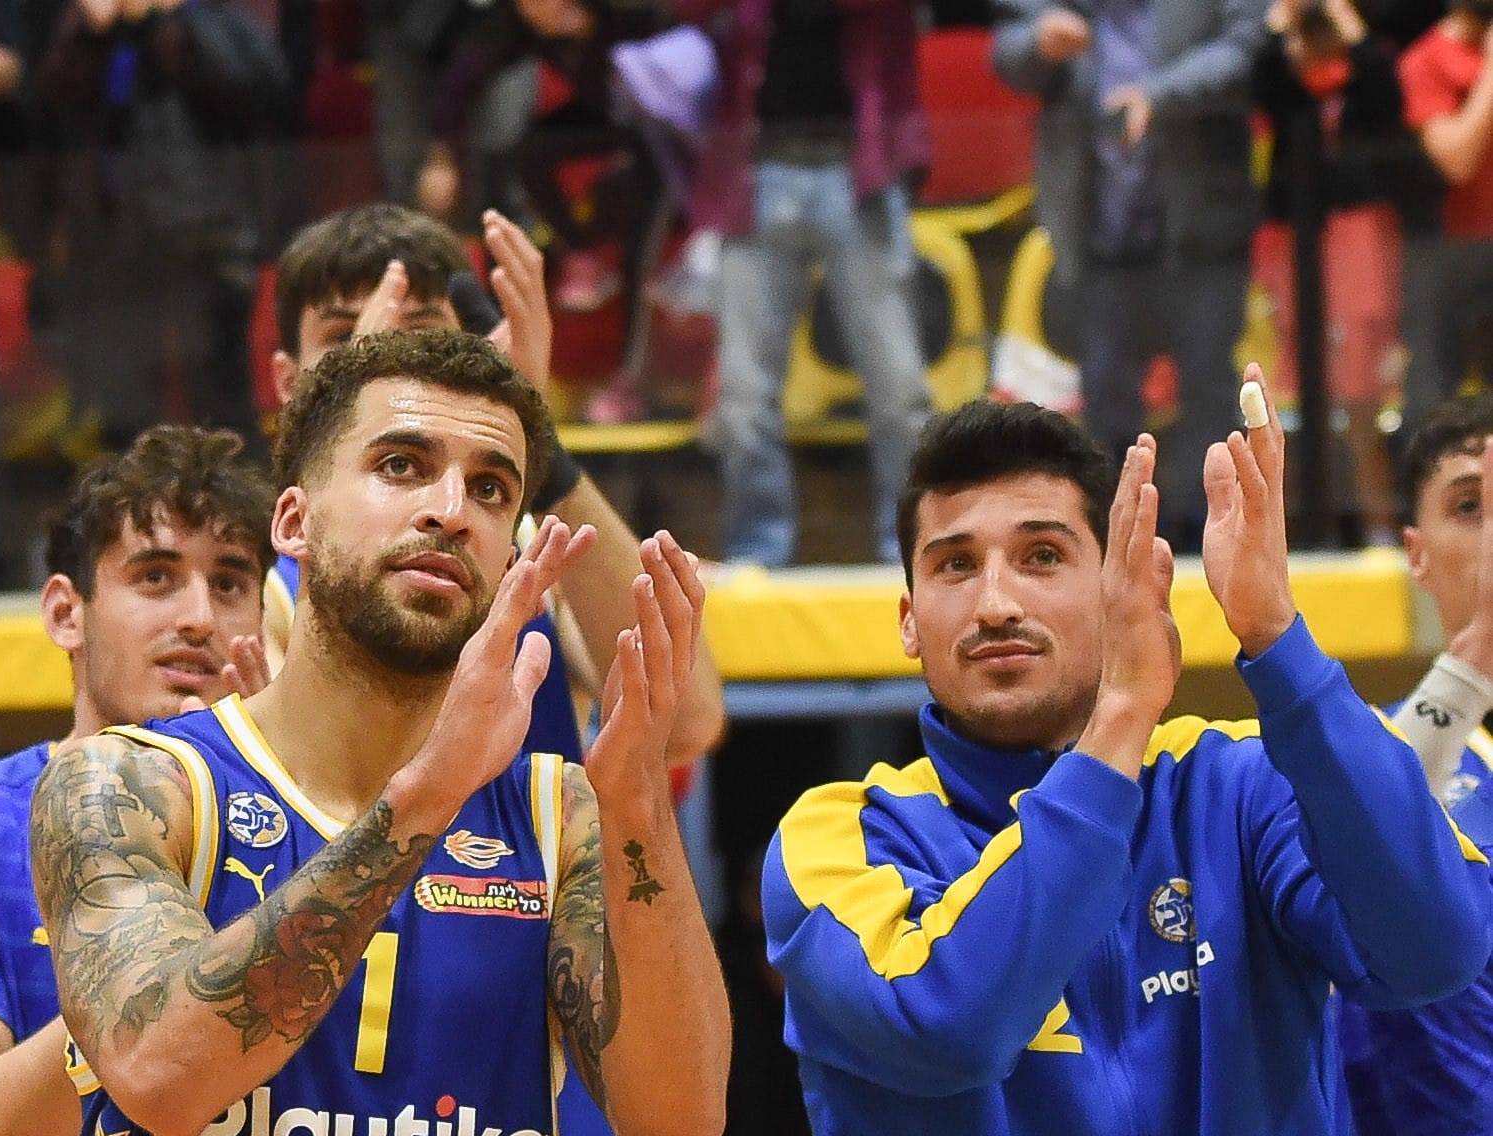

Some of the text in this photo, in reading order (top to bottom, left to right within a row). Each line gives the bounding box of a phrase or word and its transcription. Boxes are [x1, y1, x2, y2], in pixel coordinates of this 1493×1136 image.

[430, 884, 541, 912] Winner סל
[354, 931, 399, 1074] 1
